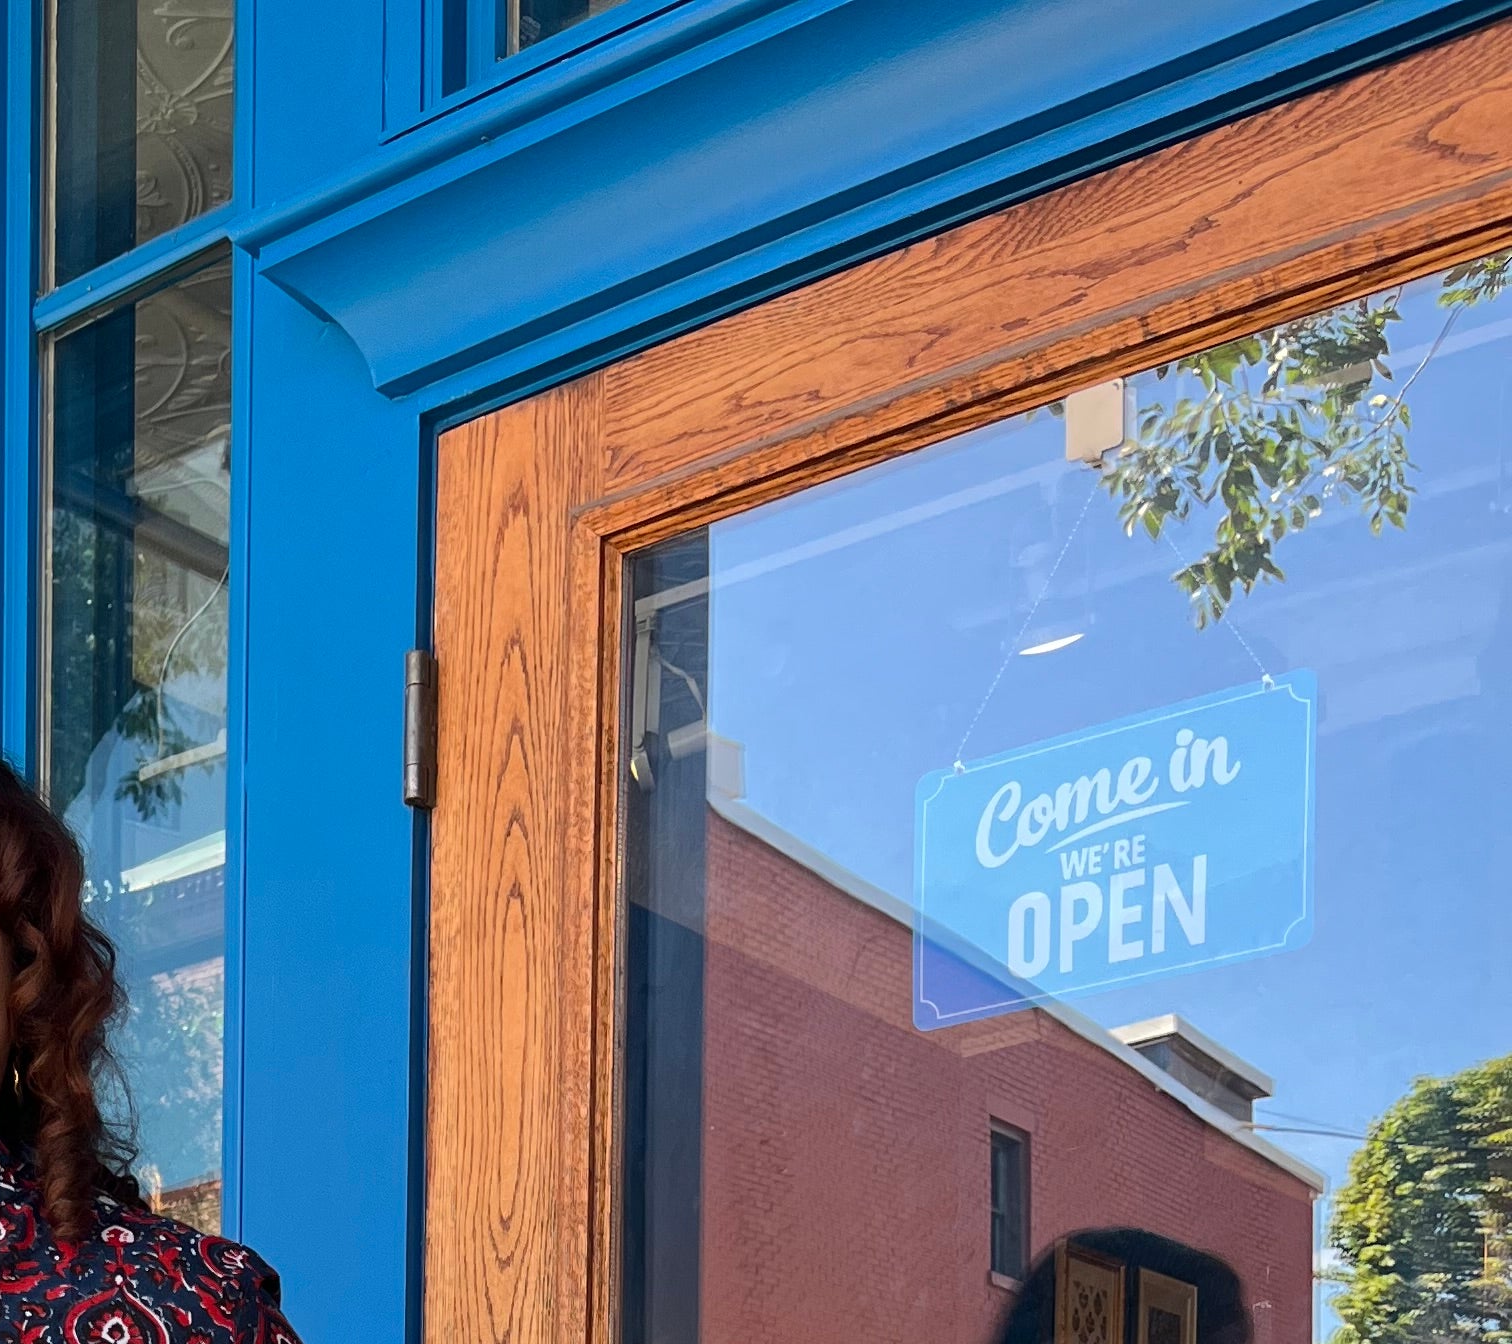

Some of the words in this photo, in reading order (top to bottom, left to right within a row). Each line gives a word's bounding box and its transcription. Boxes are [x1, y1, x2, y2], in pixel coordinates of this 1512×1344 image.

[975, 755, 1159, 869] Come
[1169, 728, 1241, 793] in
[1060, 834, 1146, 880] WE'RE
[1007, 854, 1208, 979] OPEN
